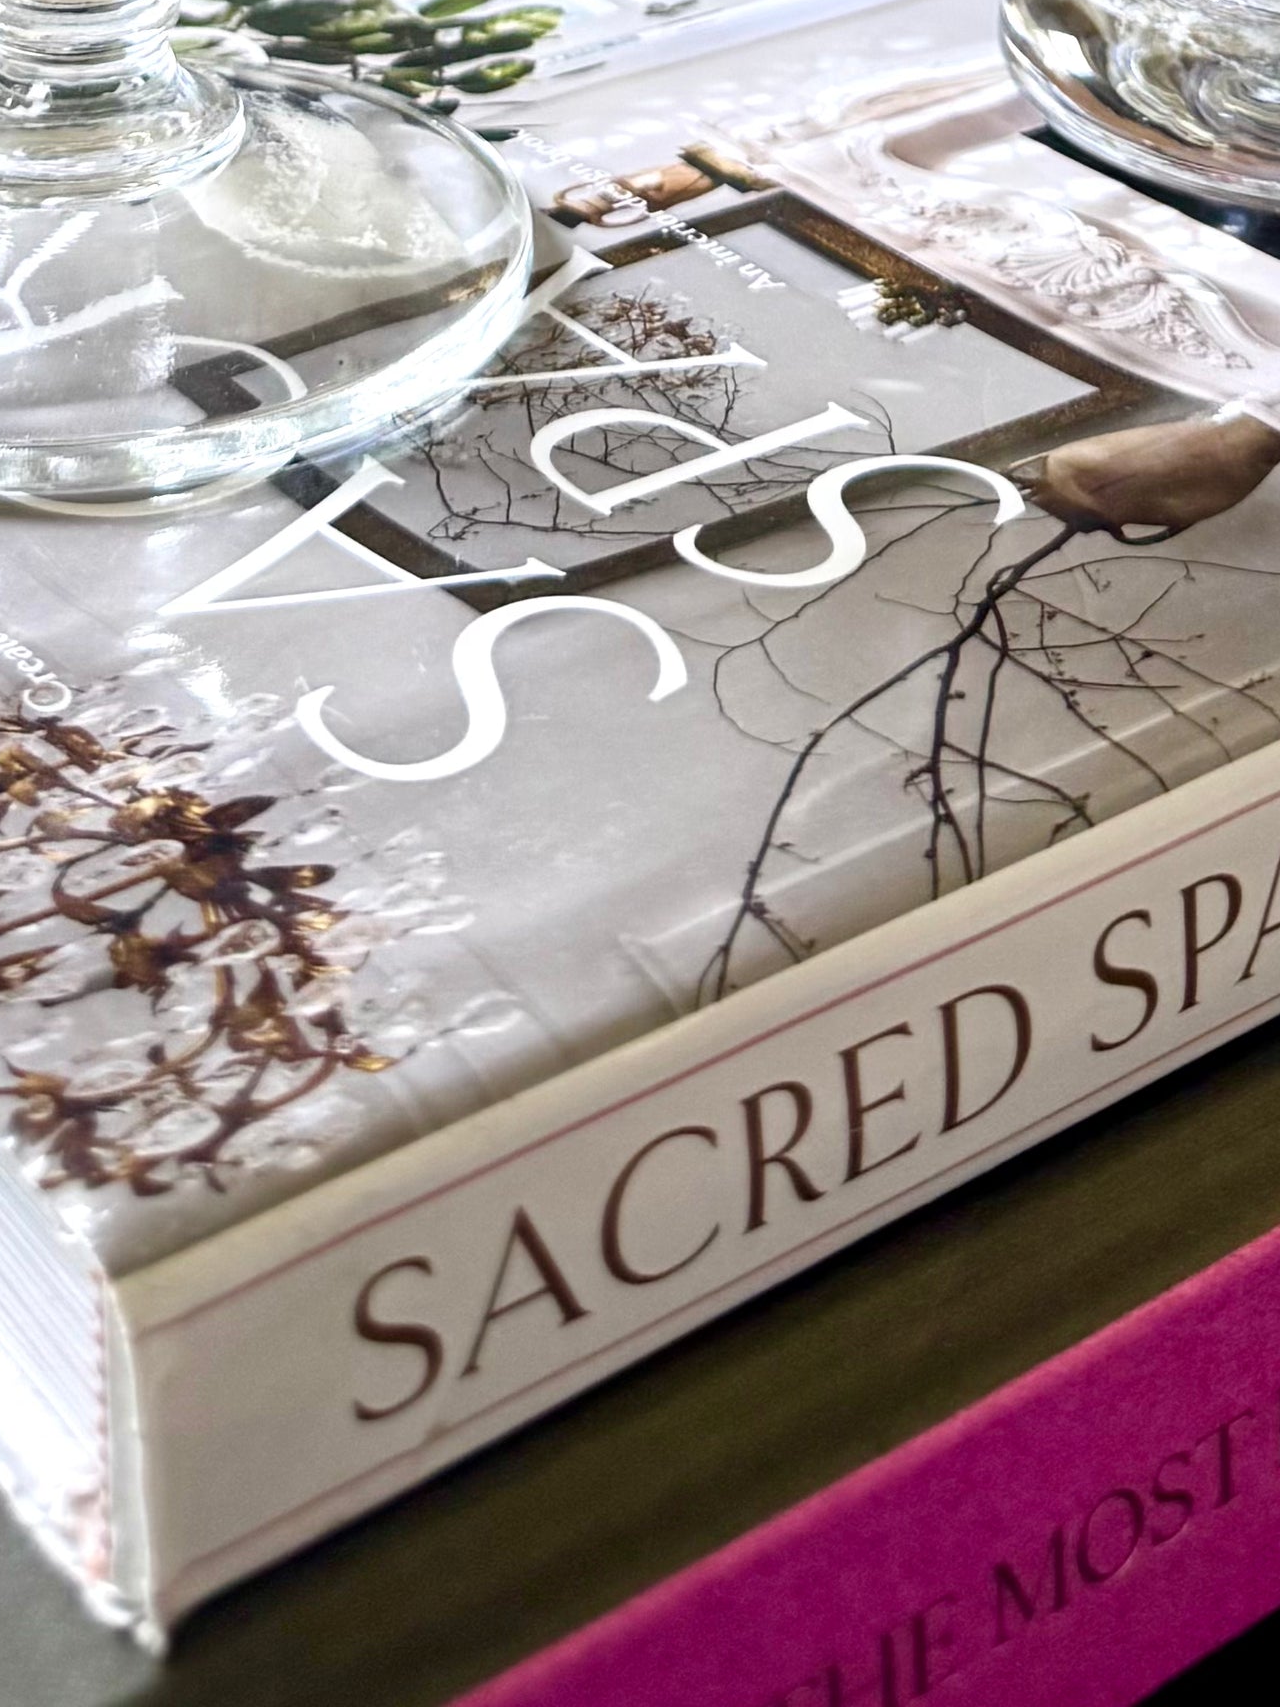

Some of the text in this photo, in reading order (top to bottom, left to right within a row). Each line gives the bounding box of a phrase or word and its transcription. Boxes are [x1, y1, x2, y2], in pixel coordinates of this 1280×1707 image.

[514, 128, 787, 290] An interior design book
[352, 983, 1034, 1424] SACRED
[990, 1408, 1257, 1649] MOST
